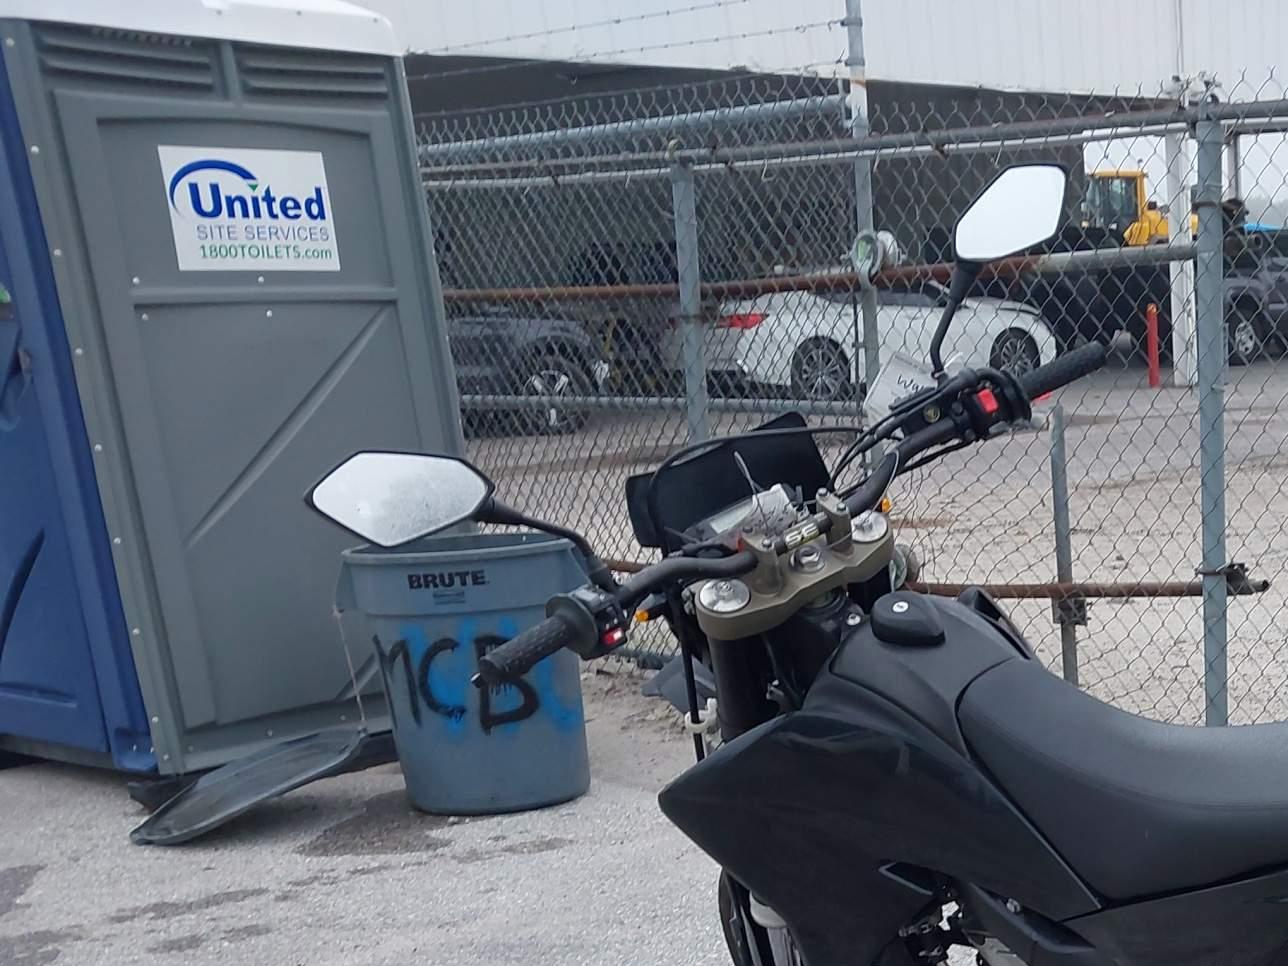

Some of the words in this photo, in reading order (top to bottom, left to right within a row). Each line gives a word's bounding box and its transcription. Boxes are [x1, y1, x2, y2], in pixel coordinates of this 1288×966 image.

[188, 182, 326, 220] United
[196, 224, 238, 241] SITE
[244, 224, 329, 242] SERVICES
[200, 244, 332, 260] 1800TOILETS.com
[407, 569, 487, 590] BRUTE
